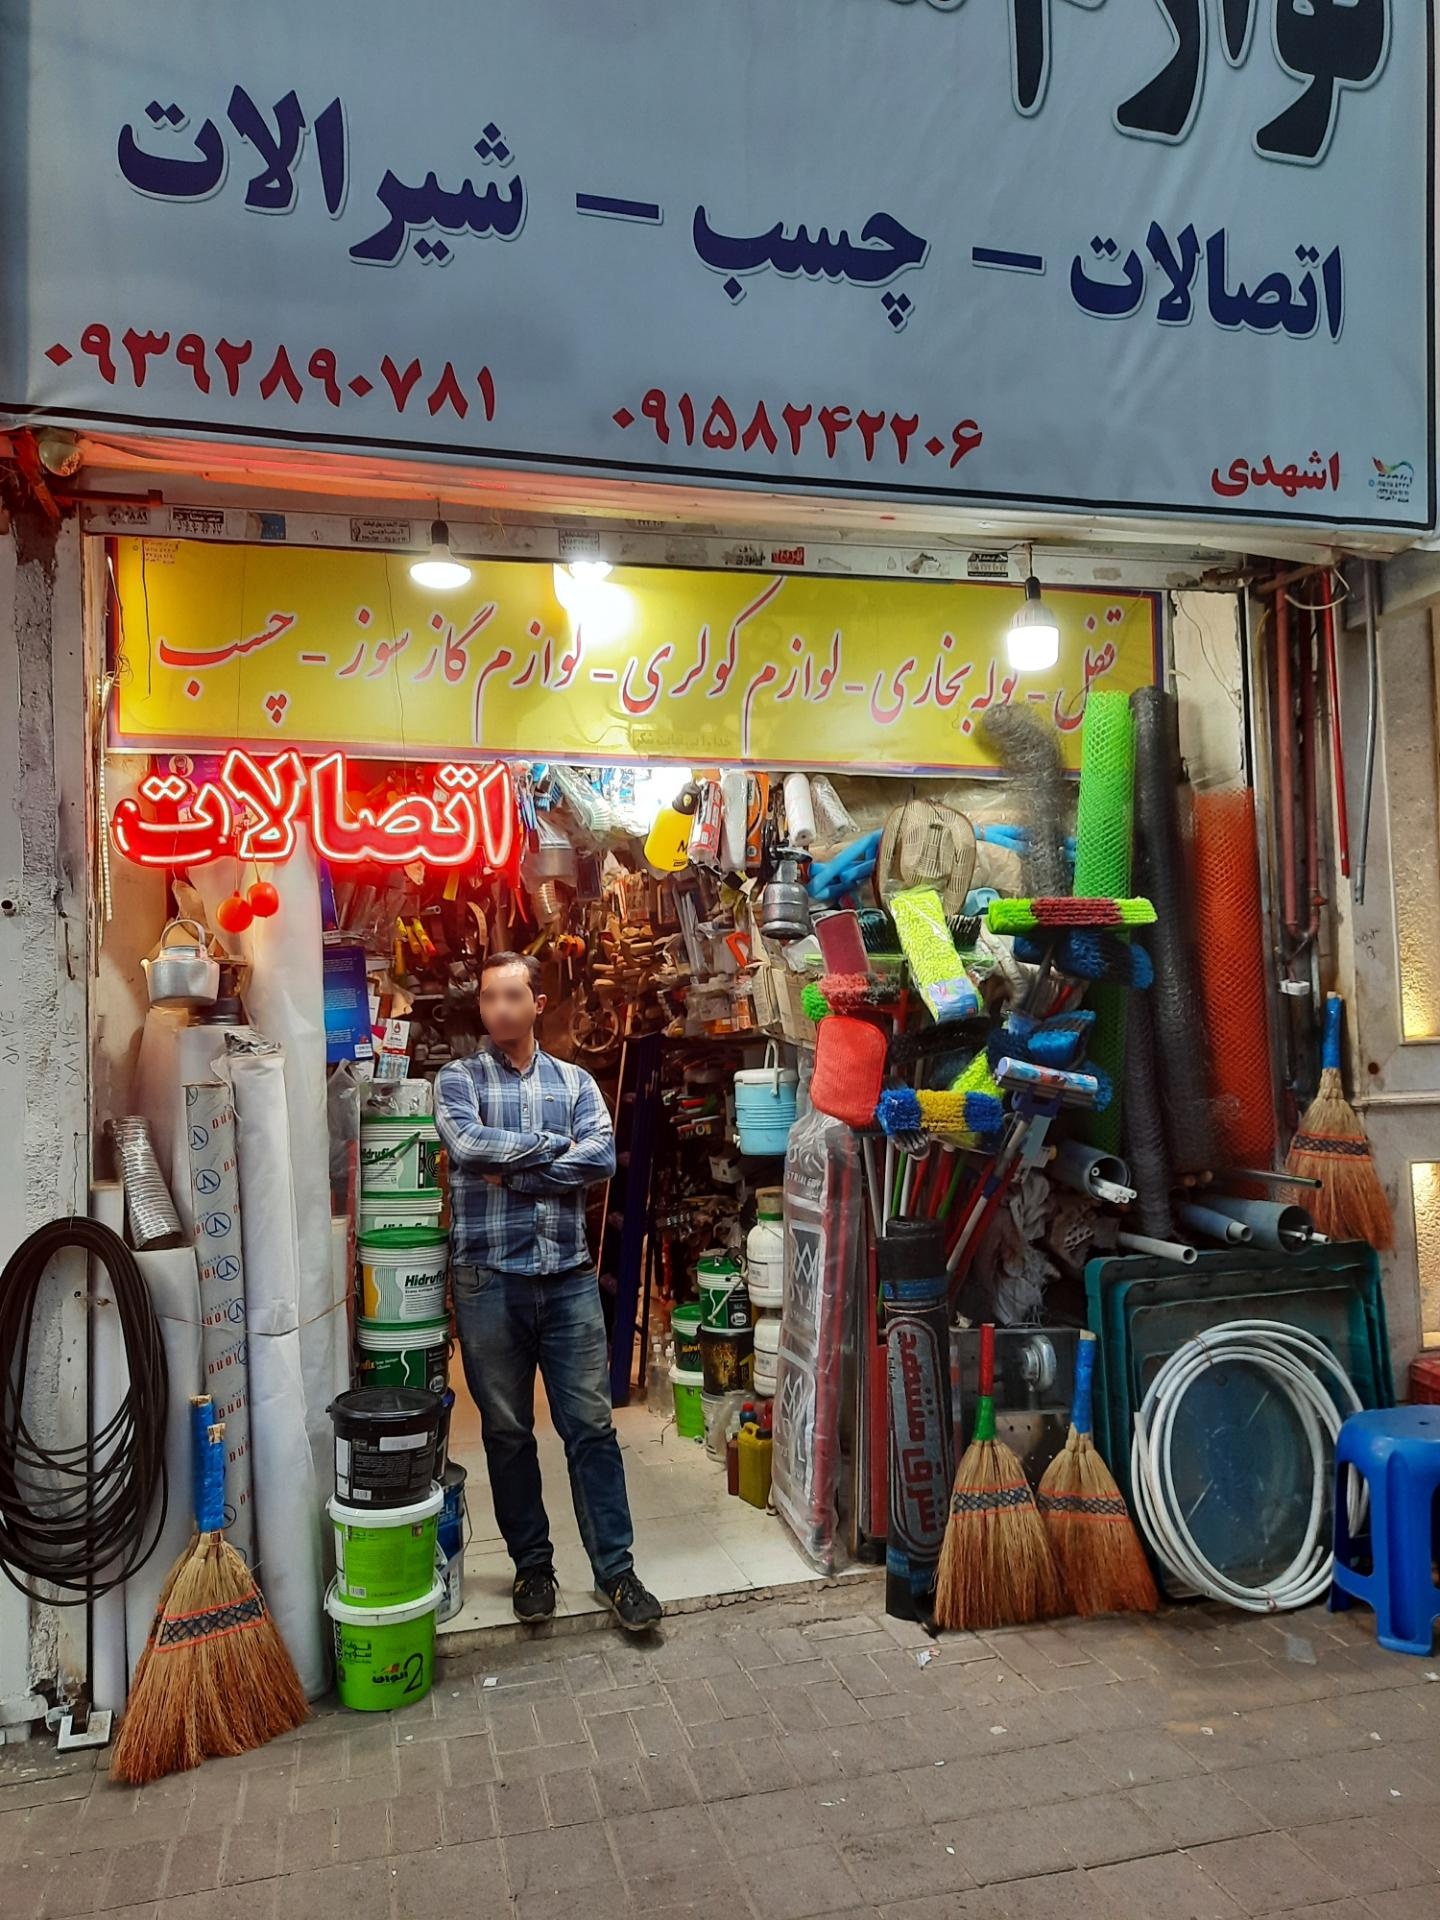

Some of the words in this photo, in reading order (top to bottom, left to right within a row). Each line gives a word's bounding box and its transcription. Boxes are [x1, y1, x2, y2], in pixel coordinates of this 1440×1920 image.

[118, 85, 526, 263] شیرالات
[693, 207, 928, 328] چسب
[1070, 222, 1343, 340] اتصالات
[45, 323, 496, 421] ۰۹۳۹۲۸۹۰۷۸۱
[612, 388, 983, 468] ۰۹۱۵۸۲۴۲۲۰۶
[158, 612, 296, 725] چسب
[474, 620, 583, 743] لوازم
[742, 631, 840, 757] لوازم
[113, 748, 514, 868] اتصالات
